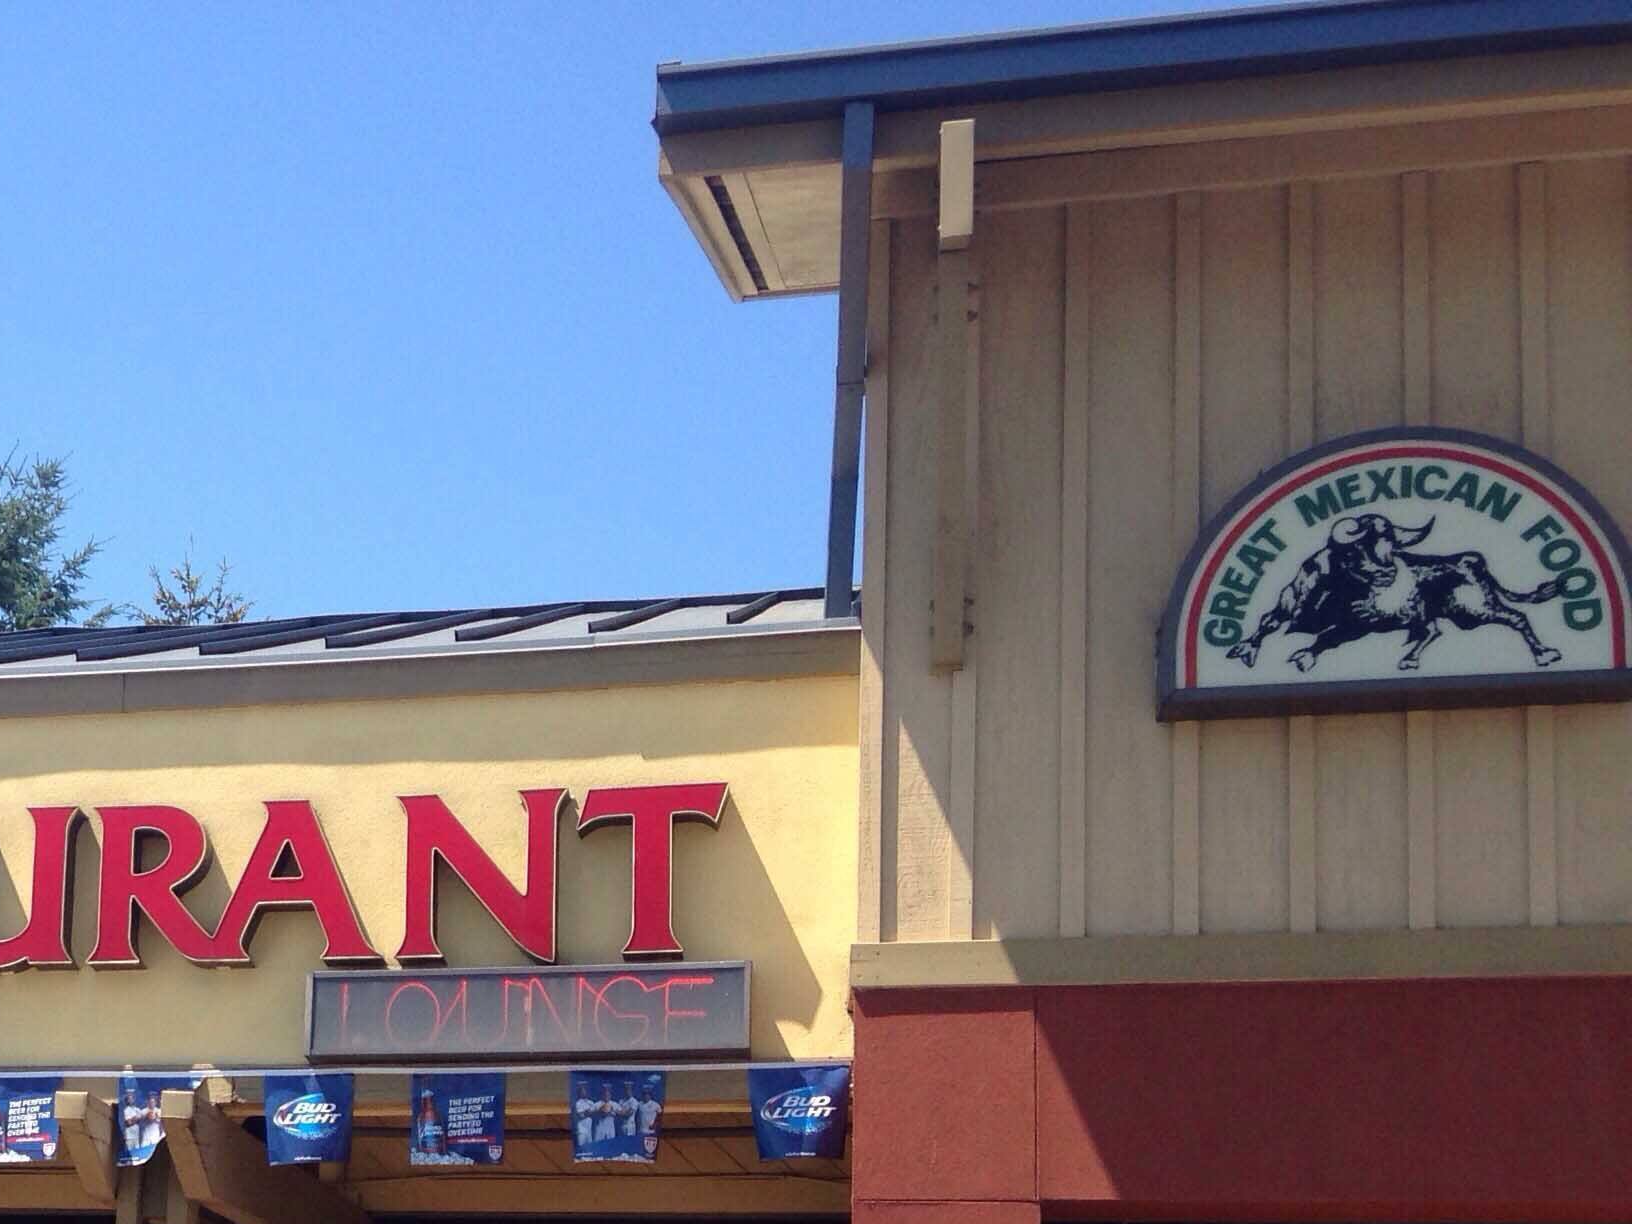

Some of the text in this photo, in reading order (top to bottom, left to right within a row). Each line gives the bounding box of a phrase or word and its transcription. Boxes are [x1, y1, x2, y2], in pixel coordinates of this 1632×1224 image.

[1202, 464, 1604, 648] GREAT MEXICAN FOOD
[336, 974, 714, 1050] LOUNGE
[782, 1095, 831, 1107] BUD
[293, 1102, 337, 1114] BUD
[772, 1106, 837, 1118] LIGHT
[283, 1113, 342, 1125] LIGHT
